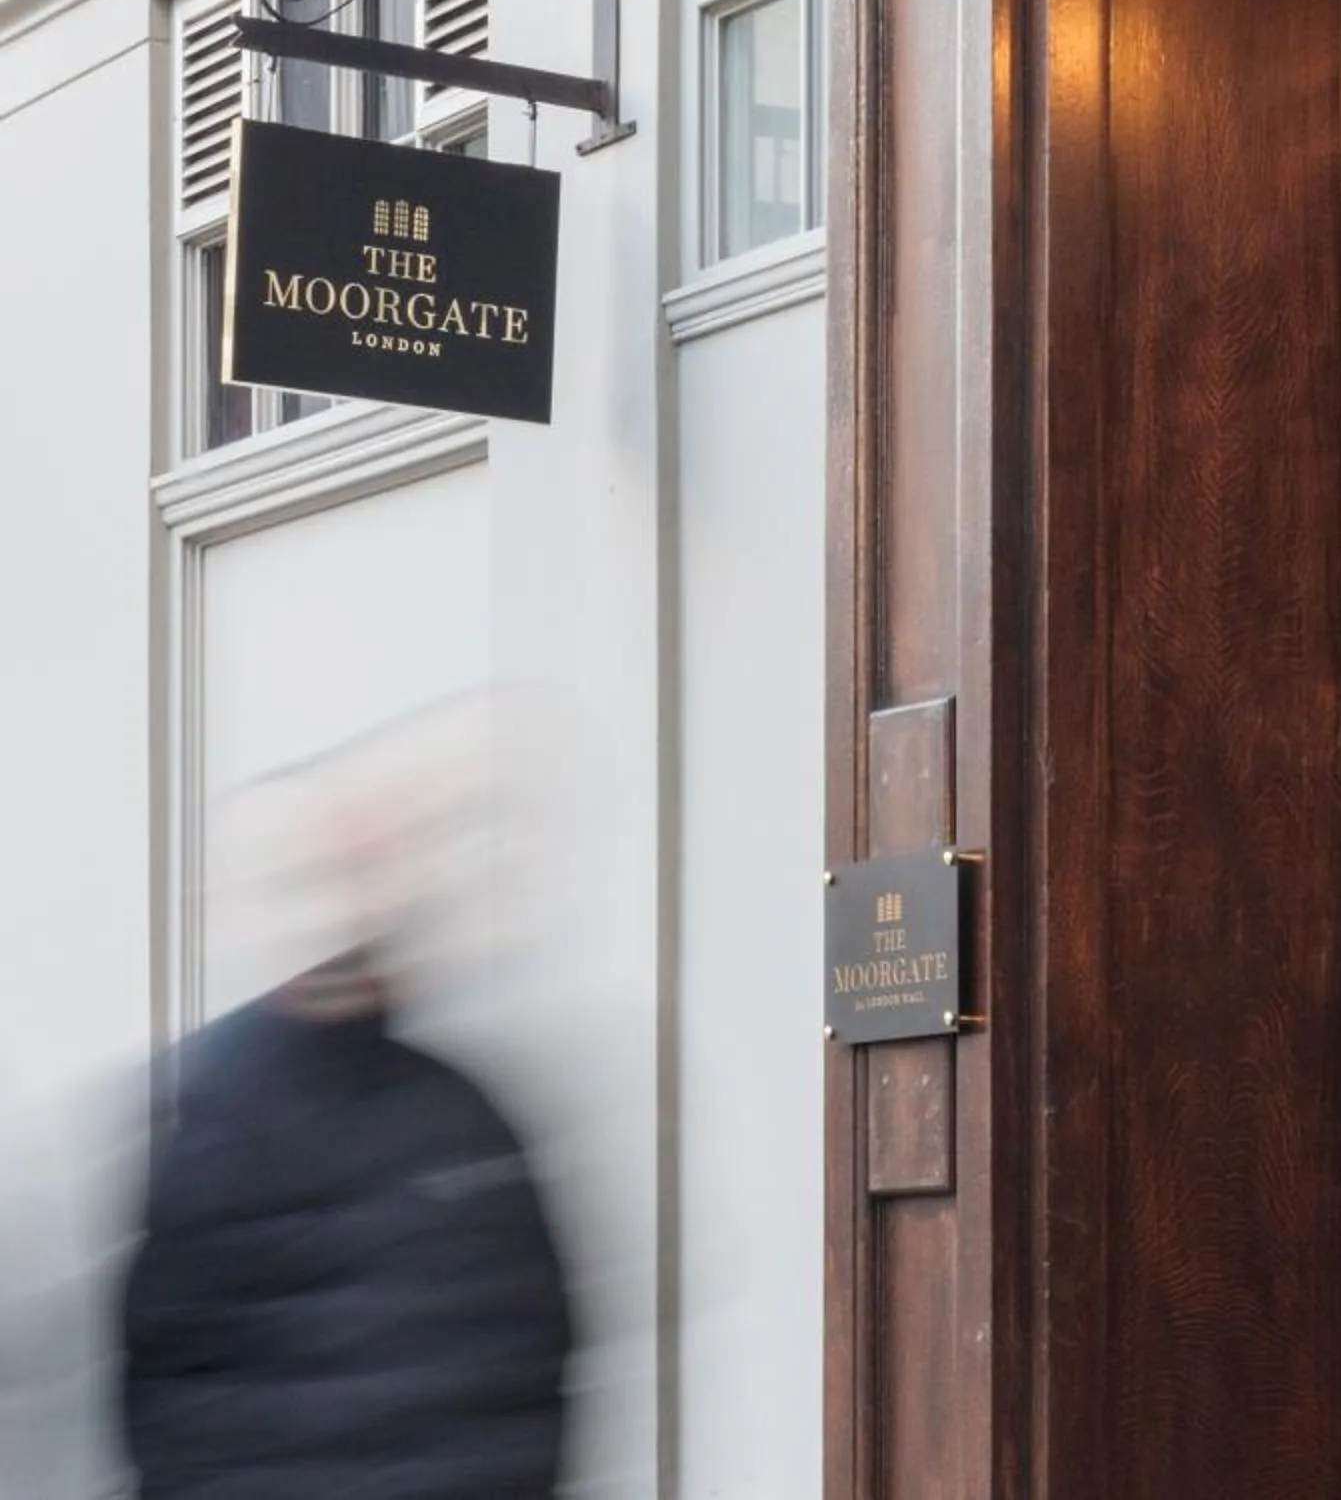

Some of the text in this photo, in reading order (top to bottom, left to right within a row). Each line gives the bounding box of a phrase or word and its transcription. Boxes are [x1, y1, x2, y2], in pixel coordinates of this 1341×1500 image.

[363, 245, 437, 283] THE
[263, 269, 529, 344] MOORGATE
[352, 331, 442, 357] LONDON
[873, 928, 906, 953] THE
[833, 952, 948, 993] MOORGATE
